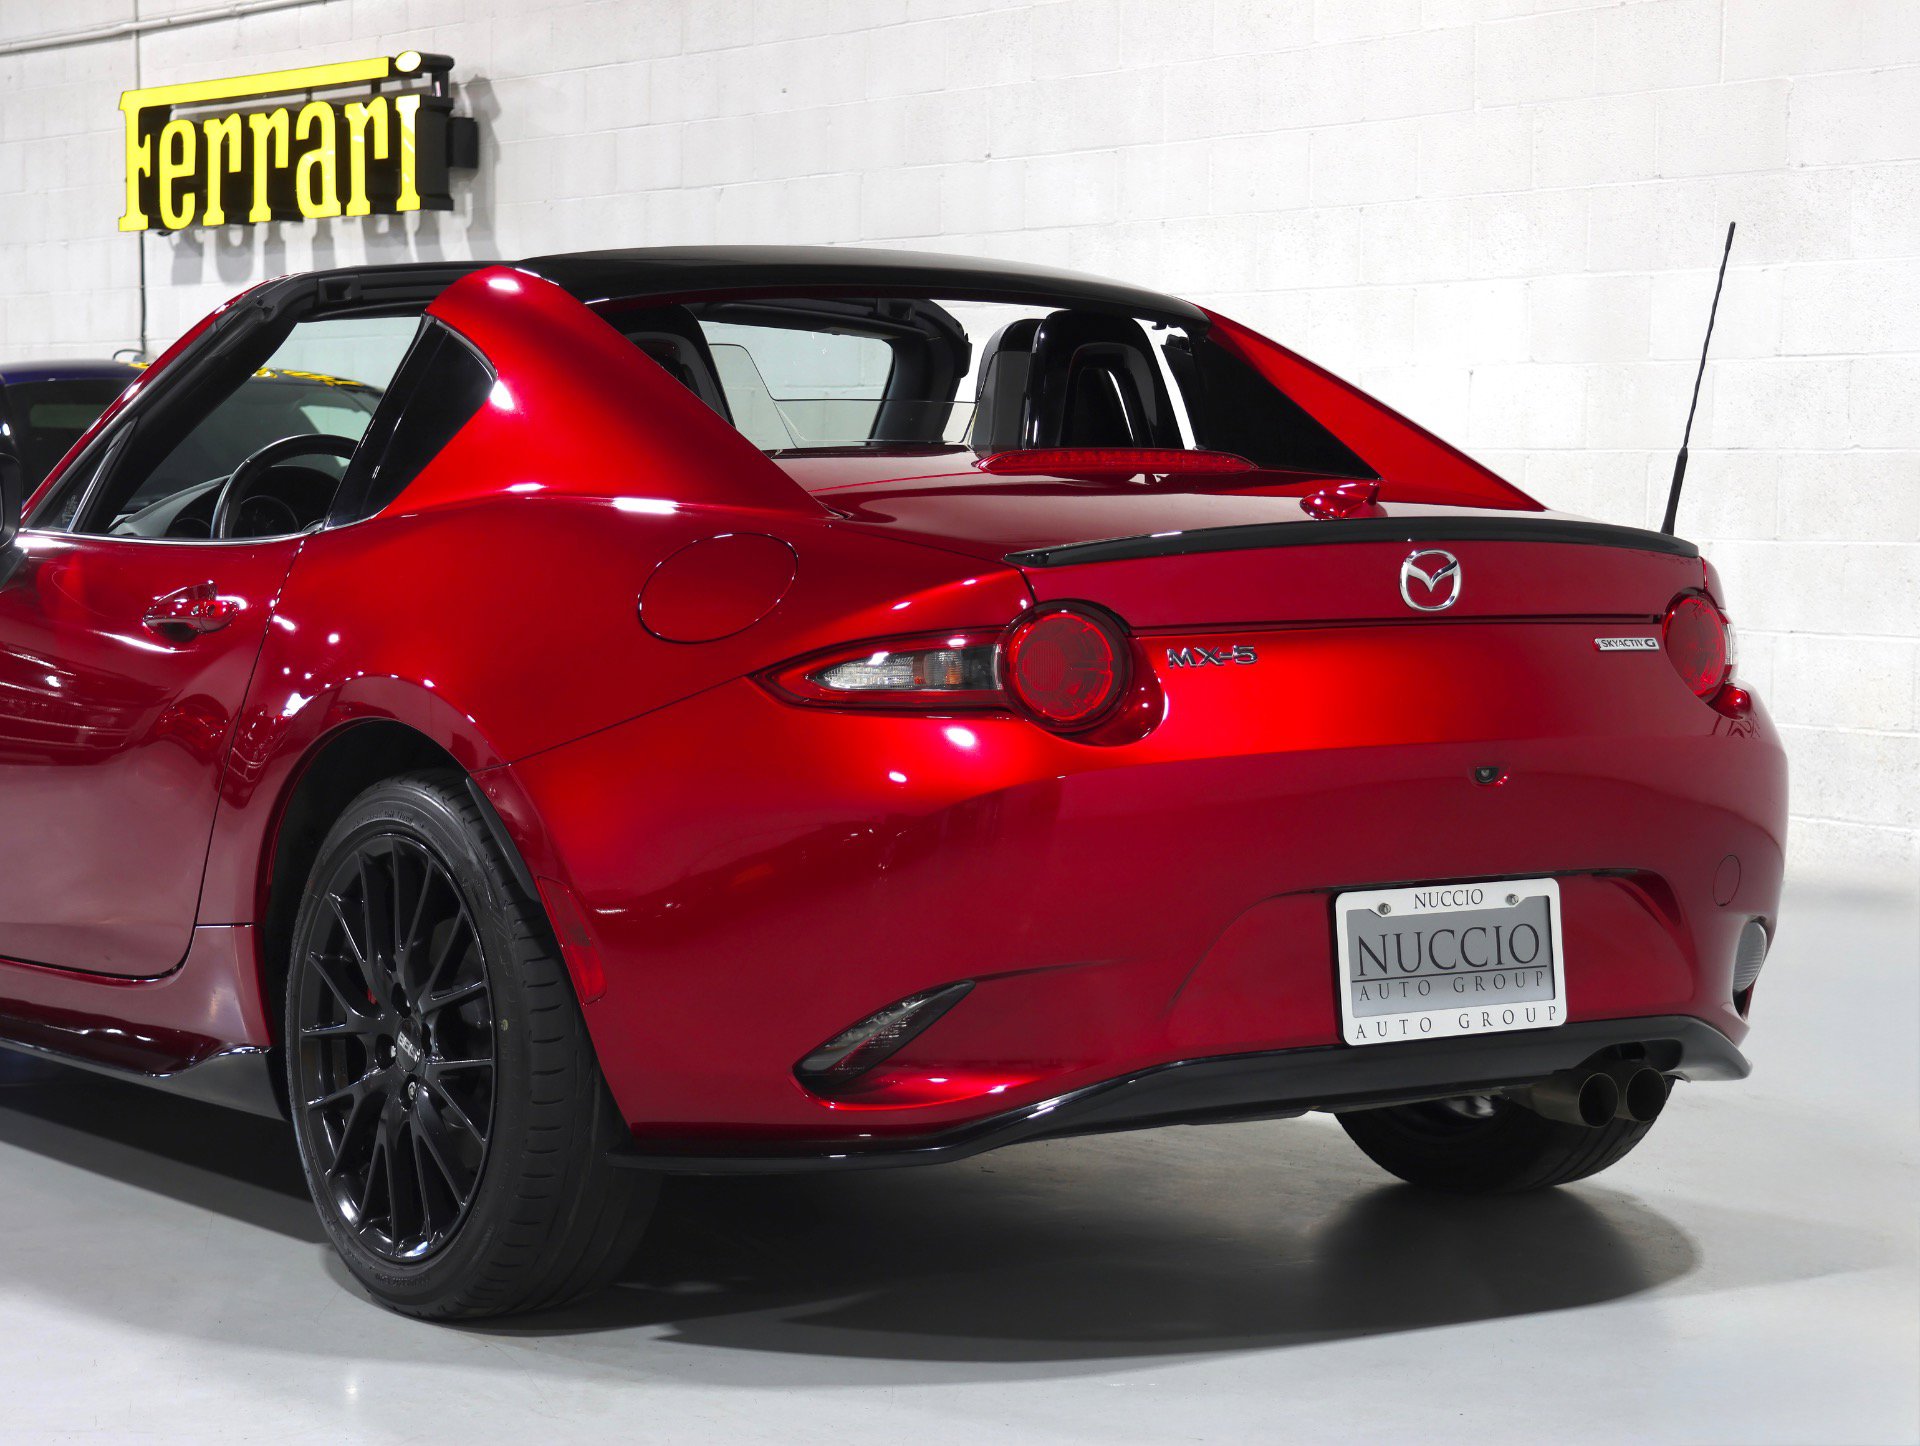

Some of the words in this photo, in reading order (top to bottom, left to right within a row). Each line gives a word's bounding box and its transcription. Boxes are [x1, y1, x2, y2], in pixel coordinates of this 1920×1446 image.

[118, 50, 422, 232] Ferrari
[1166, 644, 1258, 668] MX-5
[1414, 888, 1484, 910] NUCCIO
[1357, 923, 1540, 977] NUCCIO
[1359, 979, 1431, 1001] AUTO
[1453, 970, 1544, 994] GROUP
[1356, 1017, 1432, 1040] AUTO
[1458, 1005, 1556, 1030] GROUP
